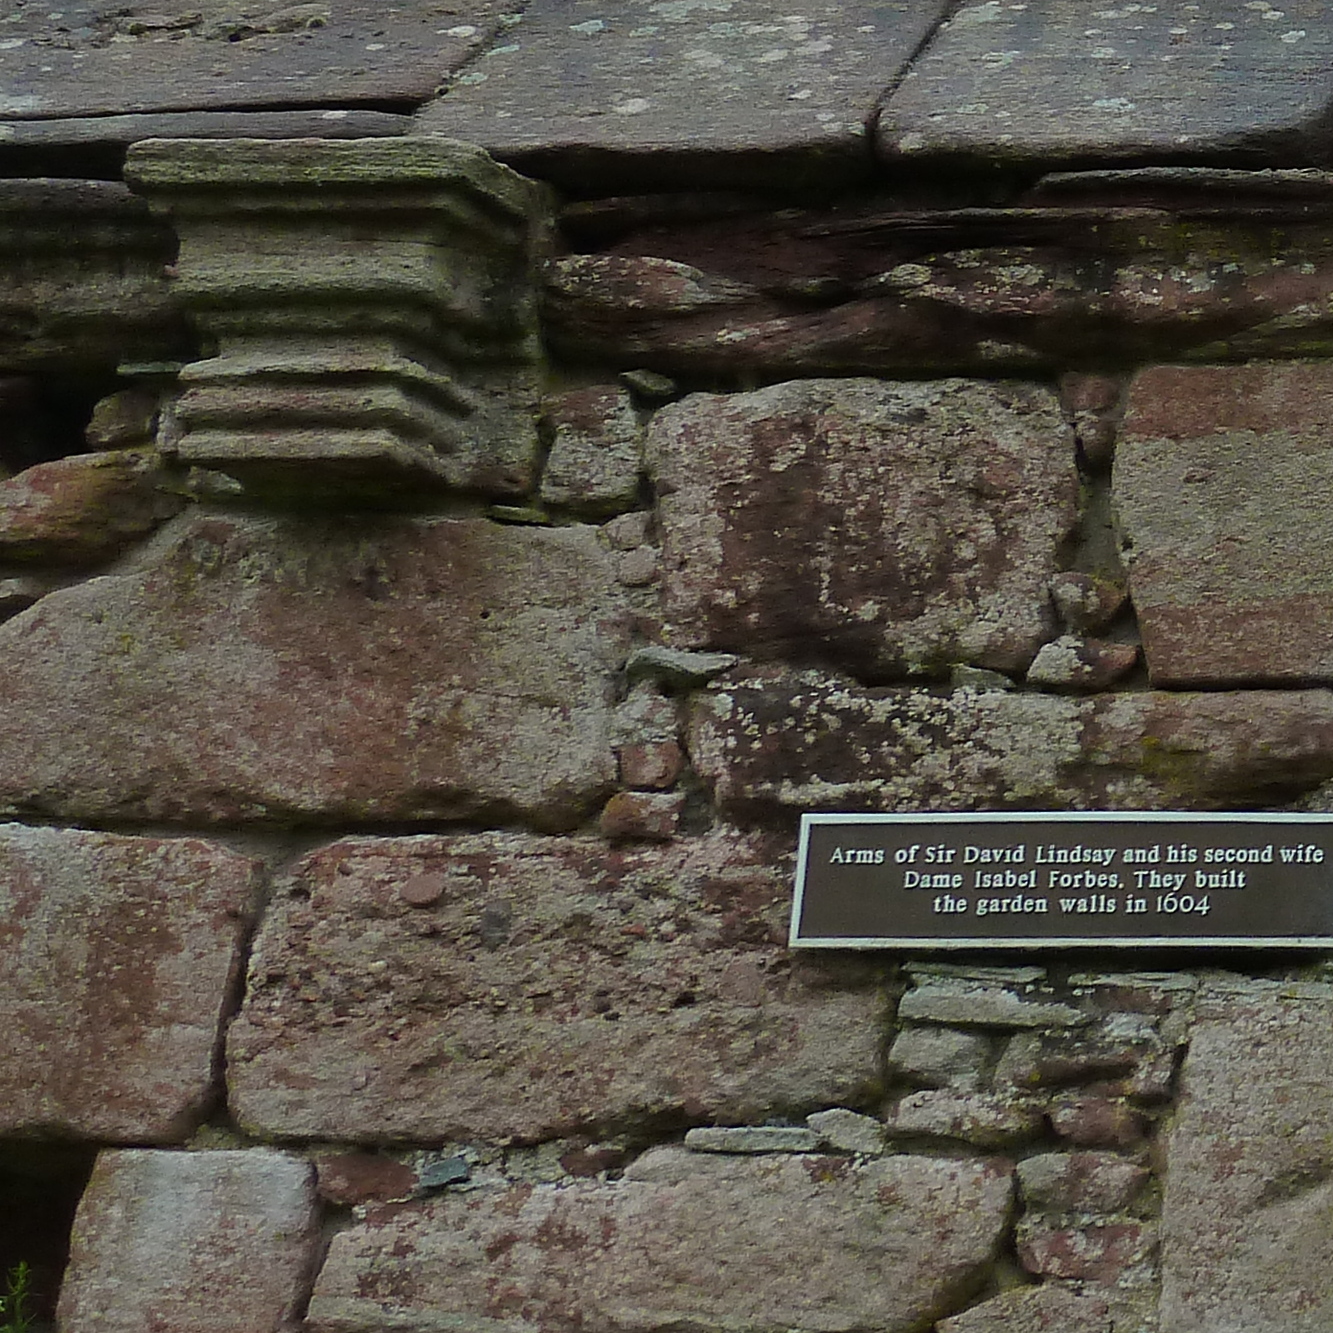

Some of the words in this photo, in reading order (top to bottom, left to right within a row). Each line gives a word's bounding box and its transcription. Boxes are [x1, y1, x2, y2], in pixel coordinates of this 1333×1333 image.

[830, 847, 885, 863] Arms
[894, 845, 921, 863] of
[925, 845, 956, 863] Sir
[963, 845, 1025, 863] David
[1035, 845, 1117, 866] Lindsay
[1122, 845, 1160, 863] and
[1166, 845, 1198, 863] his
[1204, 845, 1273, 863] second
[1280, 845, 1324, 863] wife
[904, 871, 963, 888] Dame
[974, 870, 1037, 888] Isabel
[1049, 871, 1125, 889] Forbes.
[1134, 871, 1187, 890] They
[1195, 870, 1247, 888] built
[934, 895, 967, 913] the
[976, 894, 1048, 915] garden
[1060, 894, 1117, 912] walls
[1125, 894, 1147, 913] in
[1157, 893, 1211, 915] 1604
